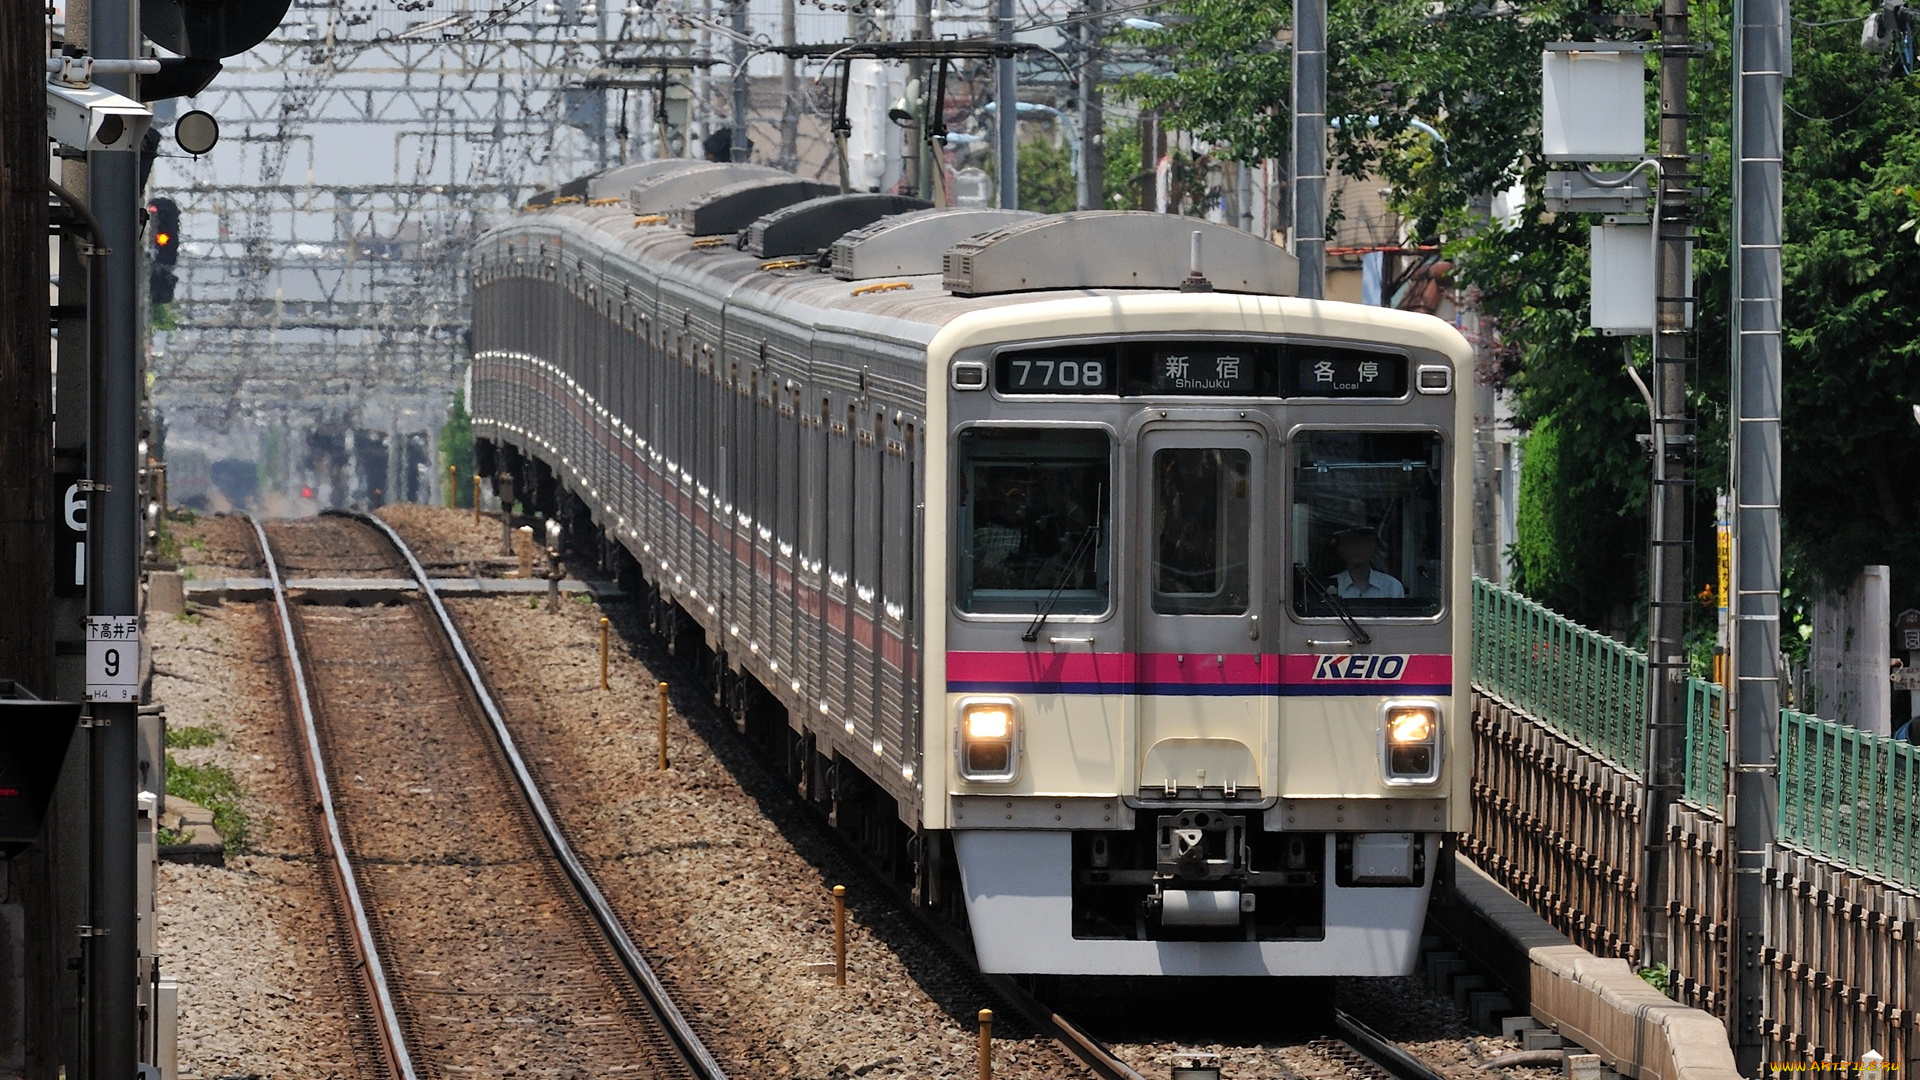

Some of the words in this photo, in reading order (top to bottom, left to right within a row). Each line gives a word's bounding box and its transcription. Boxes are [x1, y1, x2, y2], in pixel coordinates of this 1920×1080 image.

[1012, 360, 1103, 387] 7708
[1165, 355, 1240, 379] 新宿
[1314, 360, 1379, 383] 各停
[1333, 382, 1360, 390] Local
[88, 622, 137, 639] 下高井戸
[104, 648, 120, 677] 9
[1316, 655, 1404, 679] KEIO
